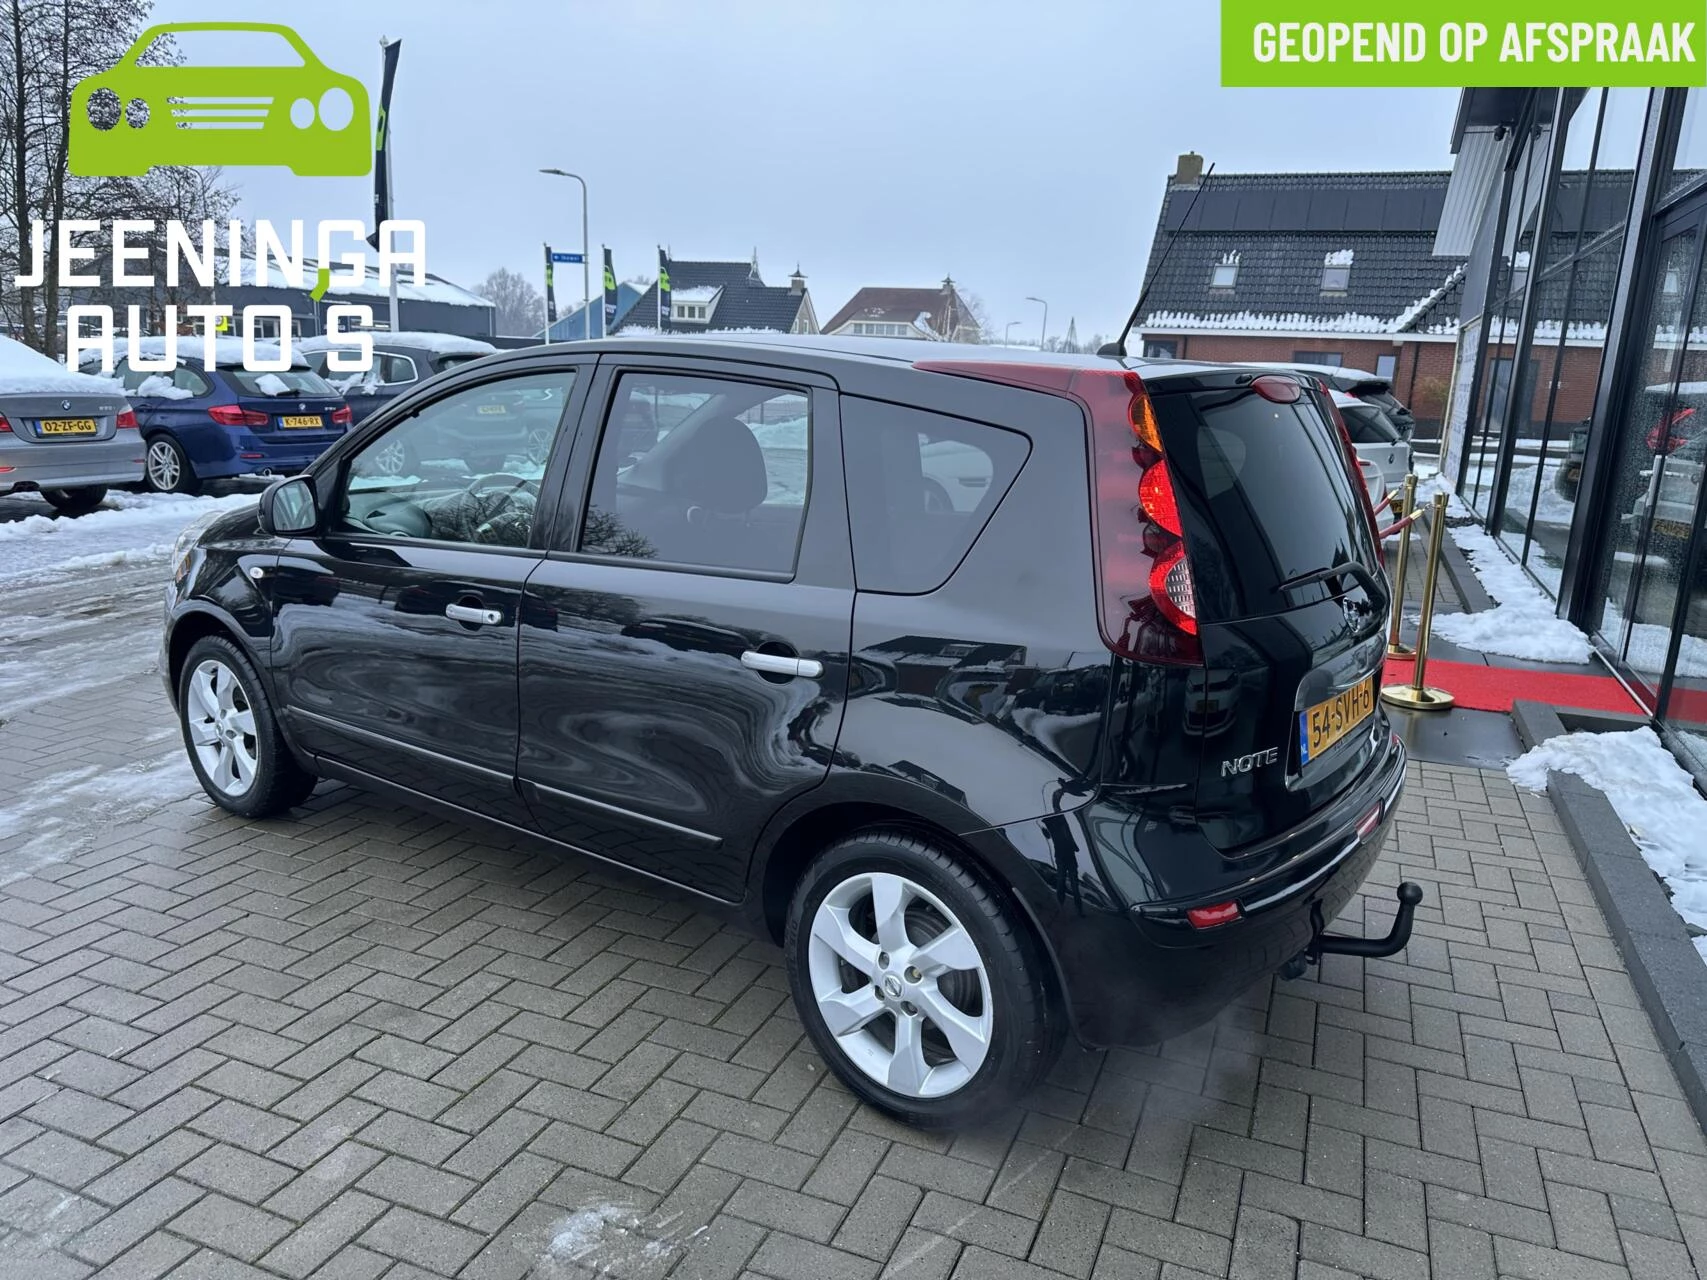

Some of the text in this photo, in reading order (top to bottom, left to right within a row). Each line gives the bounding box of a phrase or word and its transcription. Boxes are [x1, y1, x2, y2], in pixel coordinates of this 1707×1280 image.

[44, 420, 93, 433] 02-ZF-GG
[283, 417, 323, 428] K-746-RX
[1312, 682, 1370, 749] 54-SVH-6
[1220, 746, 1279, 777] NOTE
